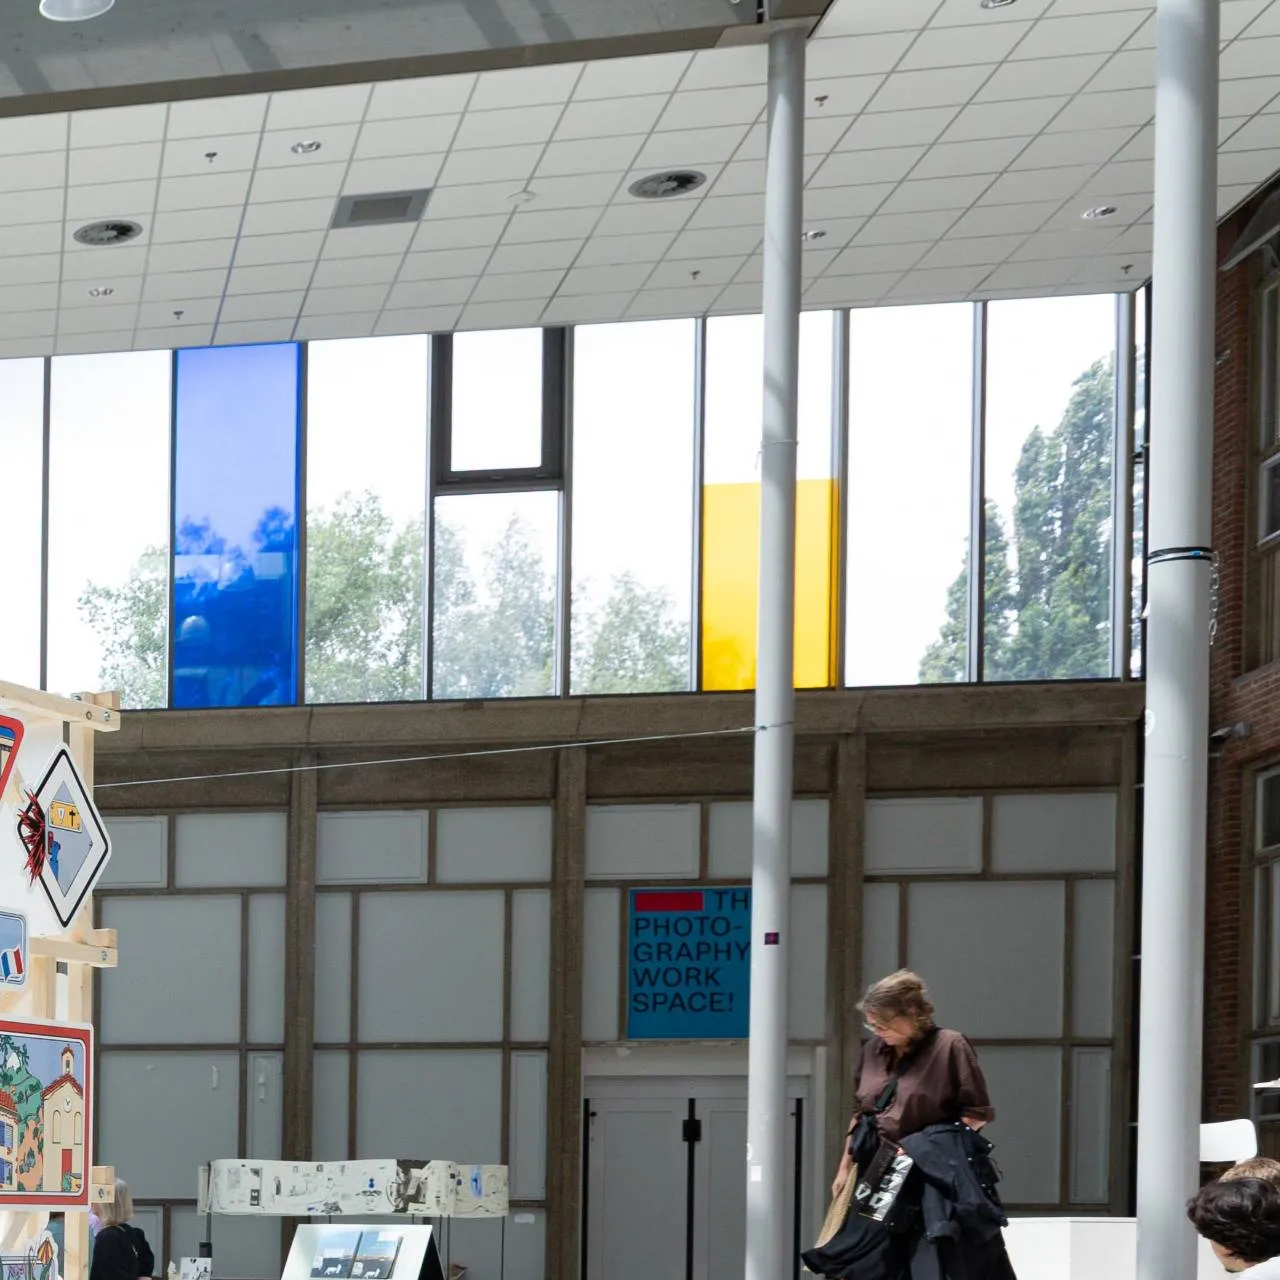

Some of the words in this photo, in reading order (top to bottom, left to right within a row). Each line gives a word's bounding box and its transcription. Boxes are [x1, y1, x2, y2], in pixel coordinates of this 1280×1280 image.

[713, 890, 750, 911] TH
[634, 916, 744, 937] PHOTO-
[633, 941, 751, 963] GRAPHY
[633, 966, 721, 988] WORK
[632, 991, 735, 1013] SPACE!
